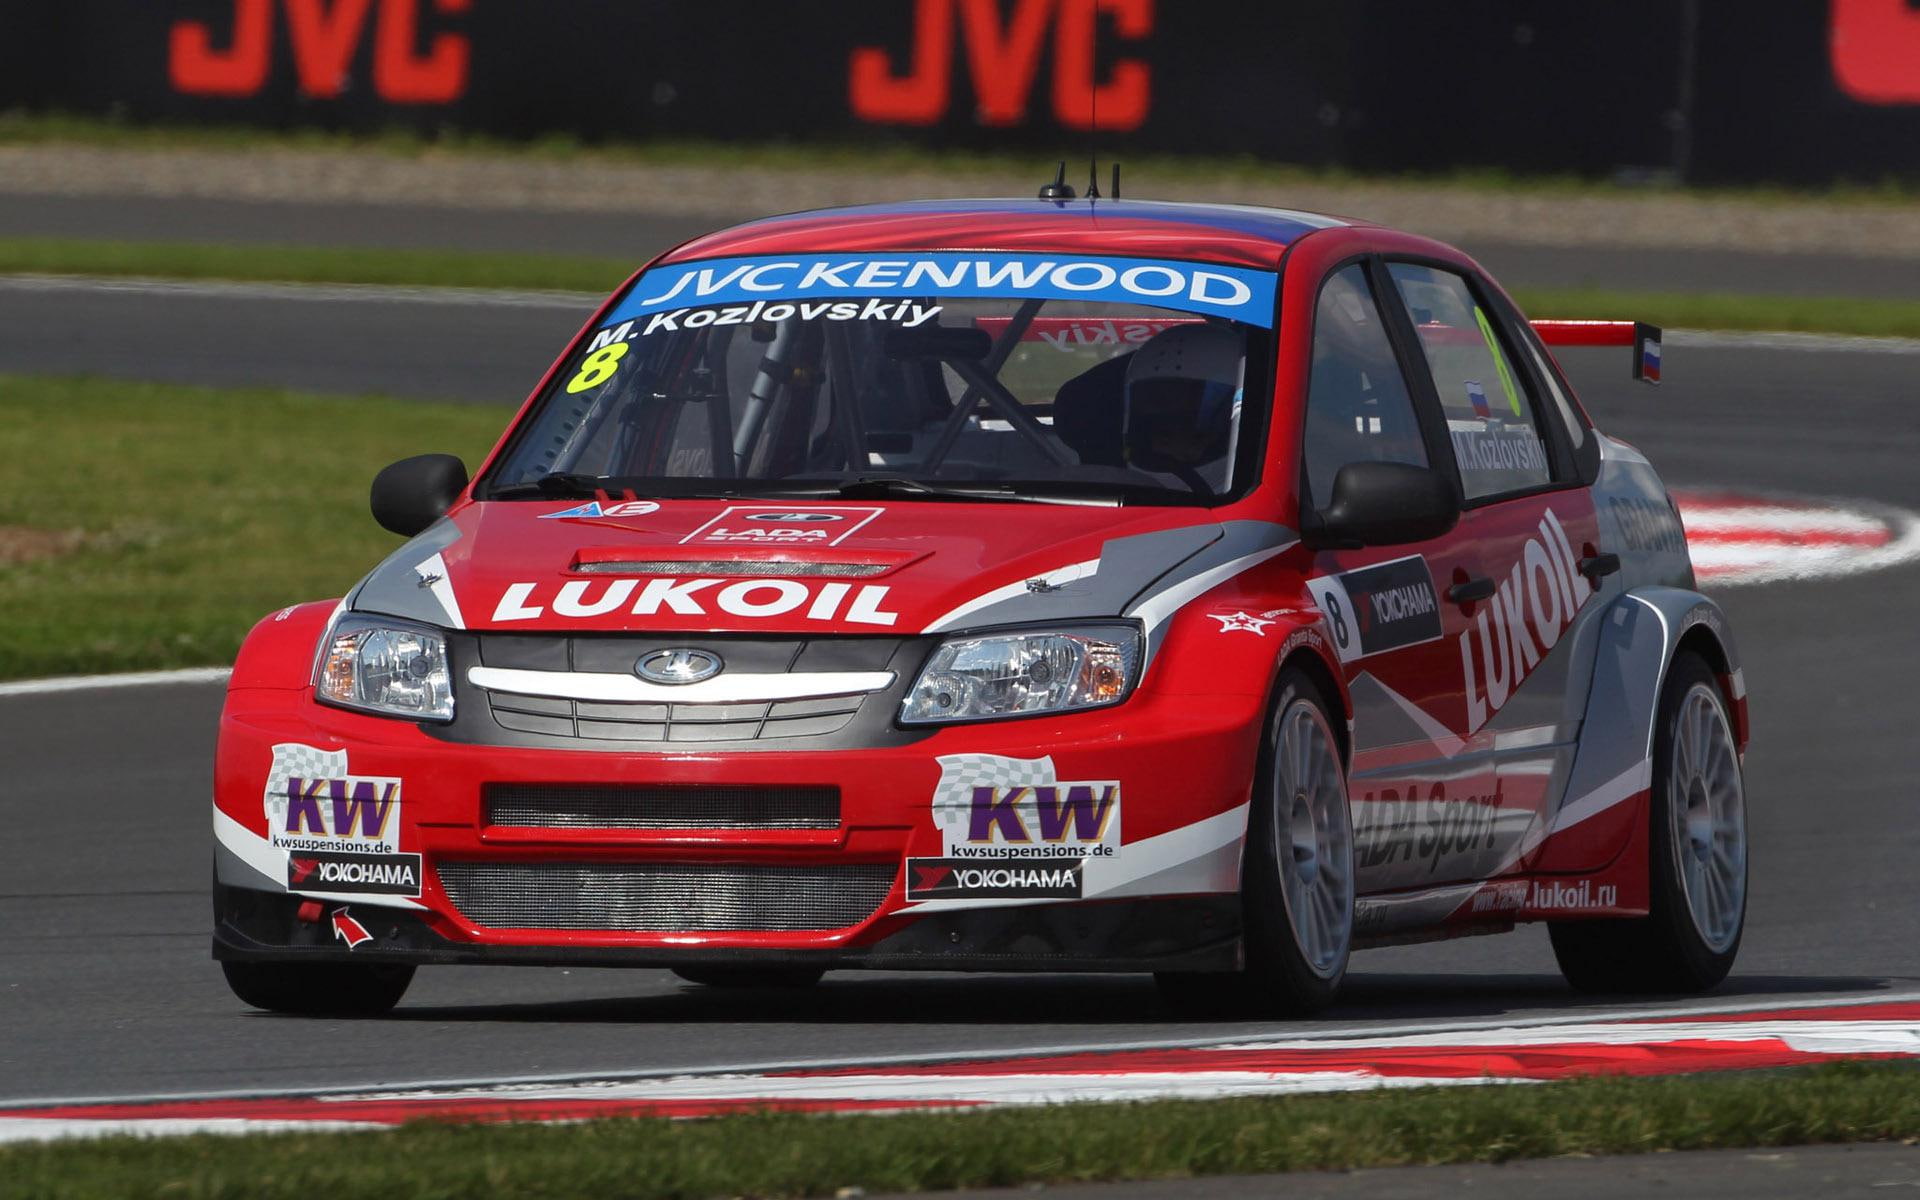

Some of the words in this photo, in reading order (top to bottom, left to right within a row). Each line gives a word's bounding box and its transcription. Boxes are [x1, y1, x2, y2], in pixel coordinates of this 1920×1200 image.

[169, 0, 472, 104] JVC
[849, 0, 1153, 129] JVC
[566, 342, 629, 394] 8
[710, 528, 828, 538] LADA
[491, 578, 899, 627] LUKOIL
[1325, 591, 1349, 650] 8
[1371, 582, 1436, 624] YOKOHAMA
[1460, 507, 1592, 737] LUKOIL
[286, 777, 400, 840] KW
[967, 785, 1119, 844] KW
[1354, 784, 1417, 869] ADA
[273, 835, 392, 854] kwsuspensions.de
[951, 843, 1114, 861] kwsuspensions.de
[318, 862, 415, 886] YOKOHAMA
[952, 869, 1077, 889] YOKOHAMA
